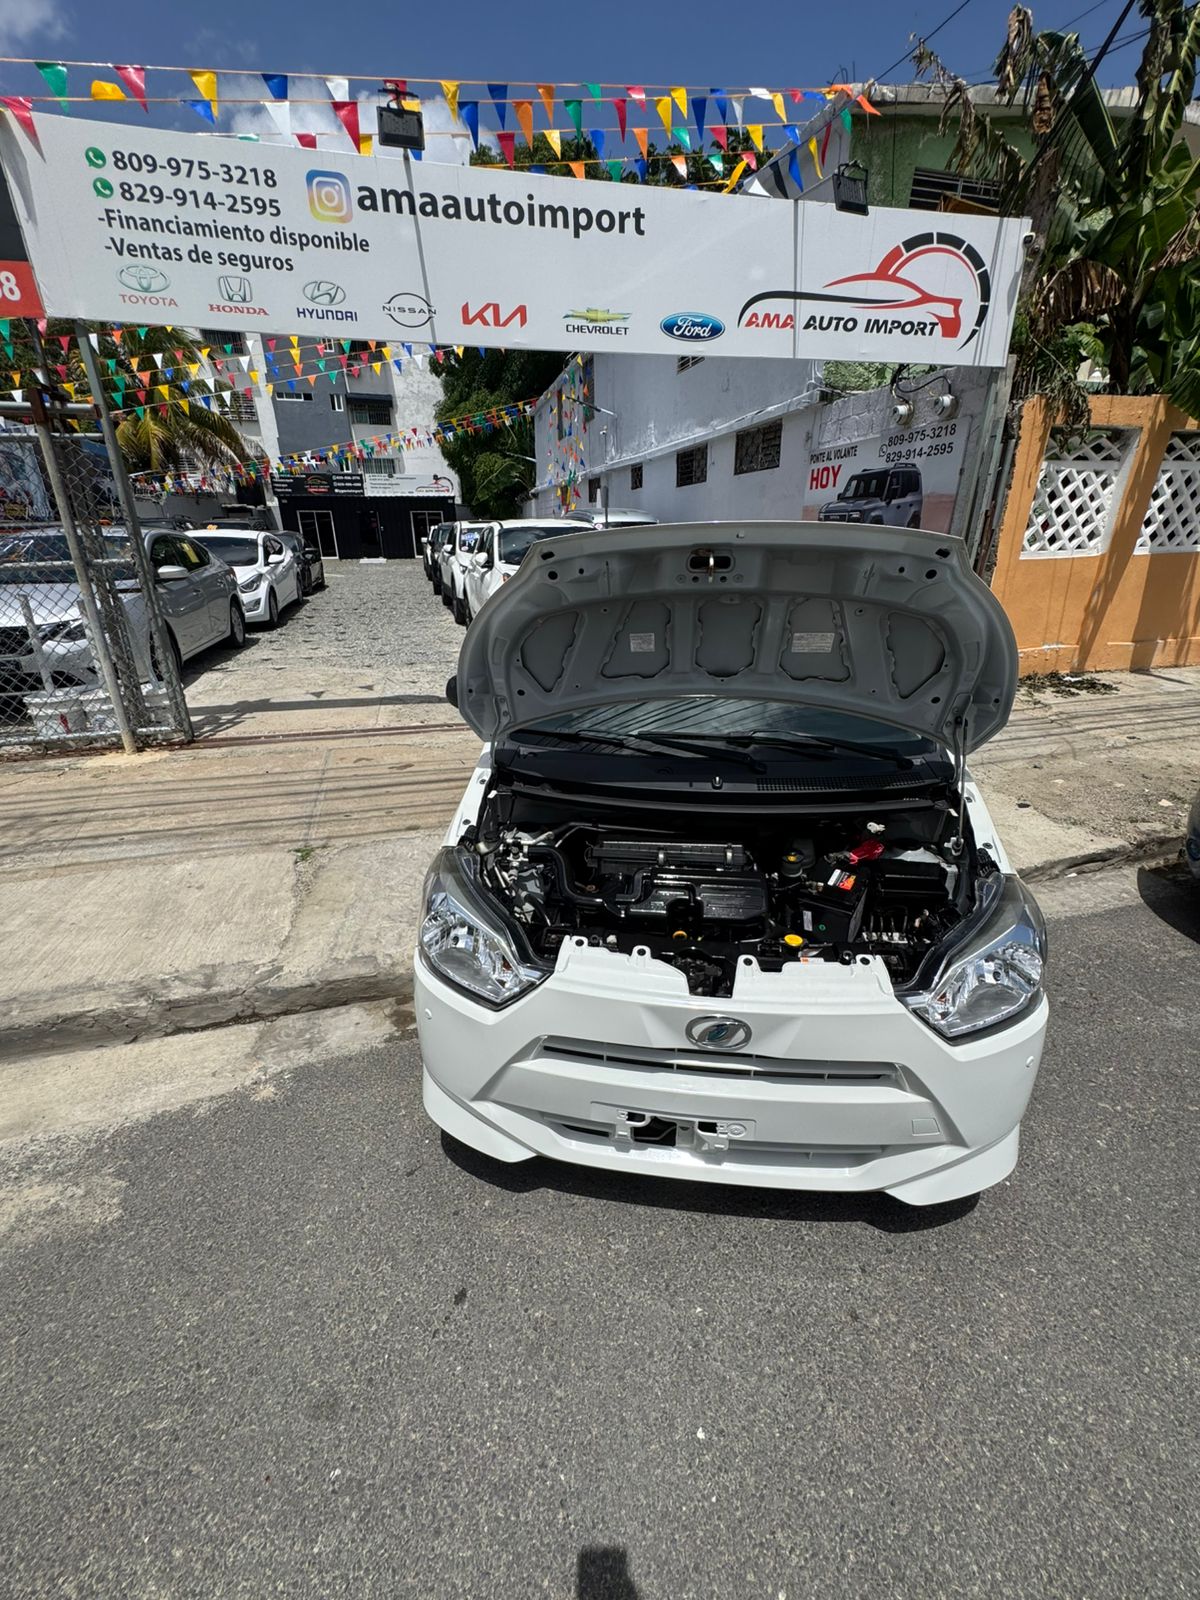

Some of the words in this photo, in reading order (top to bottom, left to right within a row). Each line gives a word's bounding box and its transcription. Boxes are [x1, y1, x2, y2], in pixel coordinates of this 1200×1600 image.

[112, 150, 278, 188] 809-975-3218
[119, 181, 282, 217] 829-914-2595
[356, 185, 646, 239] amaautoimport
[98, 208, 265, 243] -Financiamiento
[269, 225, 370, 253] disponible
[104, 236, 183, 262] -Ventas
[187, 244, 213, 265] de
[218, 251, 294, 273] seguros
[0, 271, 21, 301] 8
[119, 293, 178, 308] TOYOTA
[208, 303, 269, 317] HONDA
[382, 305, 437, 315] NISSAN
[296, 307, 358, 323] HYUNDAI
[461, 301, 527, 328] KIA
[673, 316, 713, 337] Ford
[744, 312, 794, 329] AMA
[802, 315, 858, 333] AUTO
[864, 318, 939, 337] IMPORT
[565, 324, 630, 336] CHEVROLET
[888, 423, 957, 447] 809-975-3218
[810, 451, 825, 464] PONTE
[825, 450, 832, 461] AL
[833, 445, 858, 460] VOLANTE
[885, 442, 954, 463] 829-914-2595
[809, 464, 842, 490] HOY
